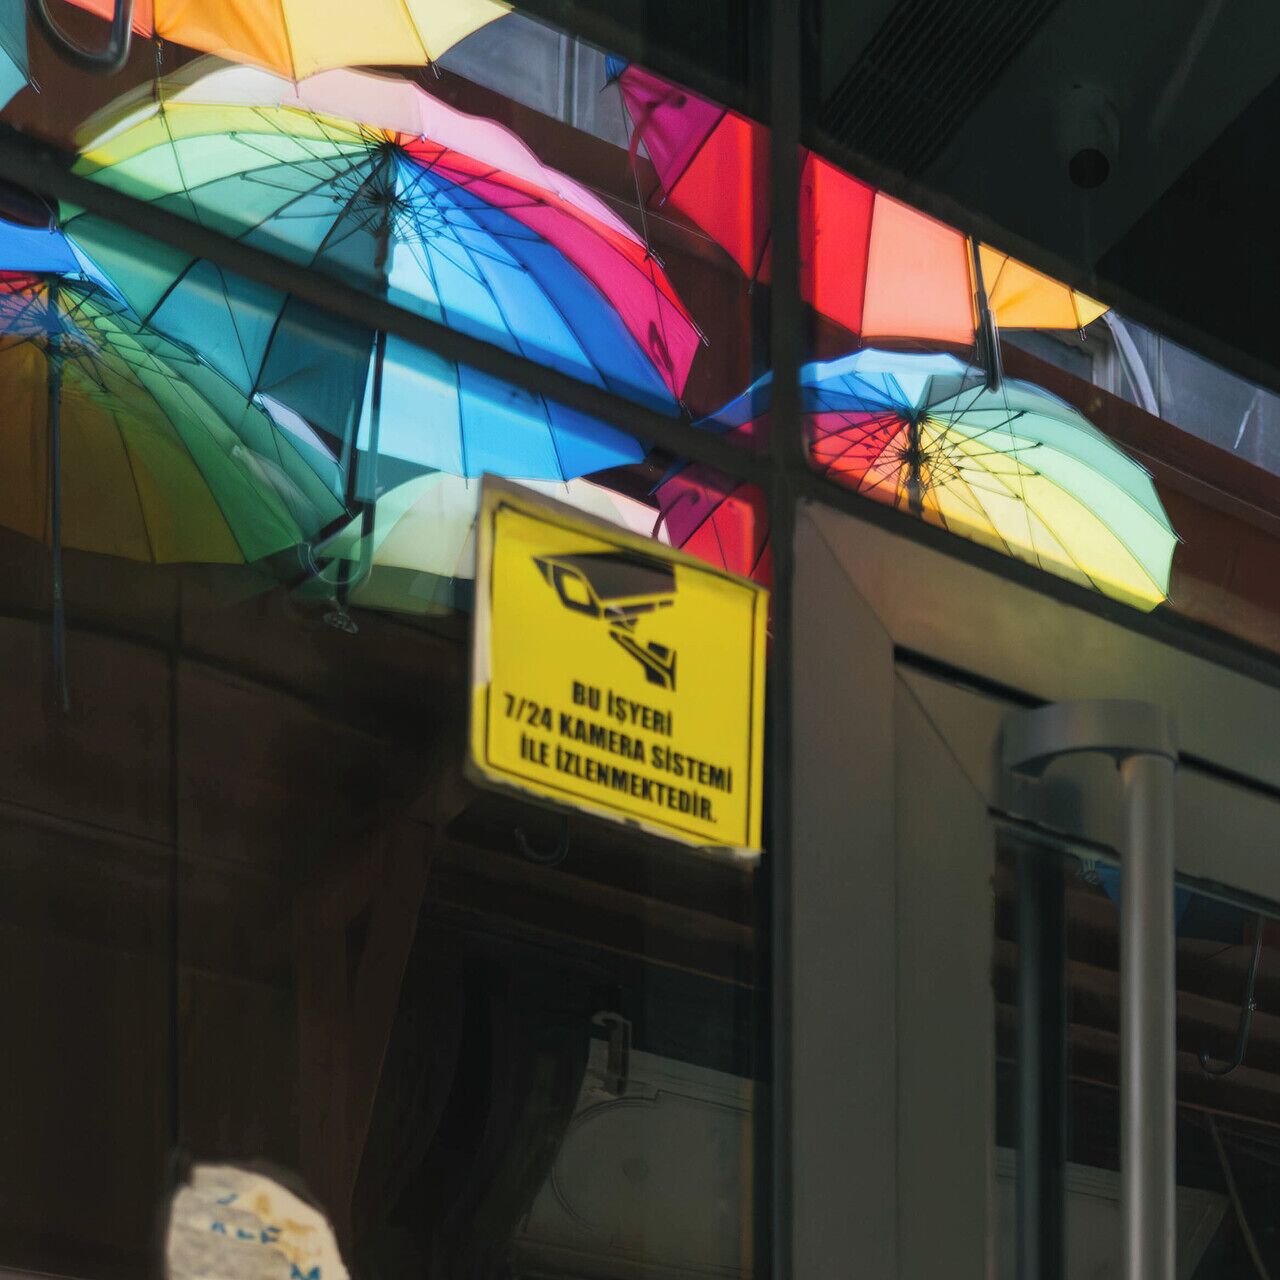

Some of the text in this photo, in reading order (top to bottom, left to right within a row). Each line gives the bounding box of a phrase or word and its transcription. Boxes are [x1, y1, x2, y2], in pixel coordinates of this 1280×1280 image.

[503, 692, 733, 793] 7/24 KAMERA SİSTEMİ
[572, 681, 674, 737] BU İŞYERİ
[520, 735, 719, 823] İLE İZLENMEKTEDİR.
